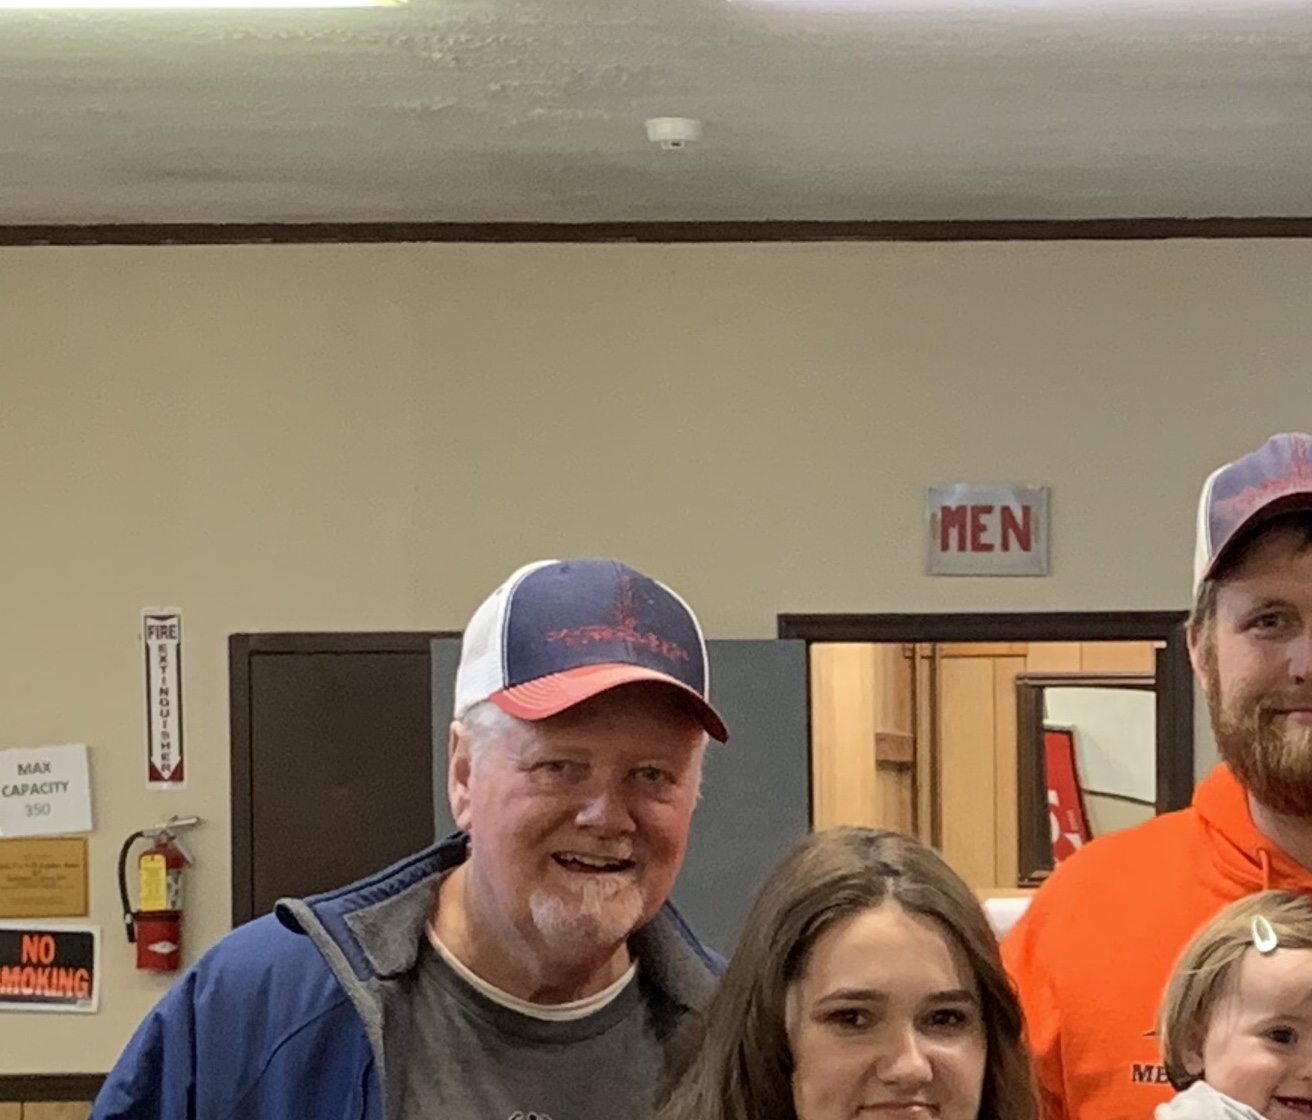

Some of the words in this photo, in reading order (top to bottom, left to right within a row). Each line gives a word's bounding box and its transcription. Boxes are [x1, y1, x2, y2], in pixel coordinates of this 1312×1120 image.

[940, 505, 1032, 552] MEN
[148, 624, 177, 640] FIRE
[158, 644, 172, 772] EXTINGUISHER
[17, 762, 51, 775] MAX
[1, 780, 69, 798] CAPACITY
[25, 802, 51, 817] 350
[22, 934, 55, 964] NO
[0, 965, 90, 998] MOKING
